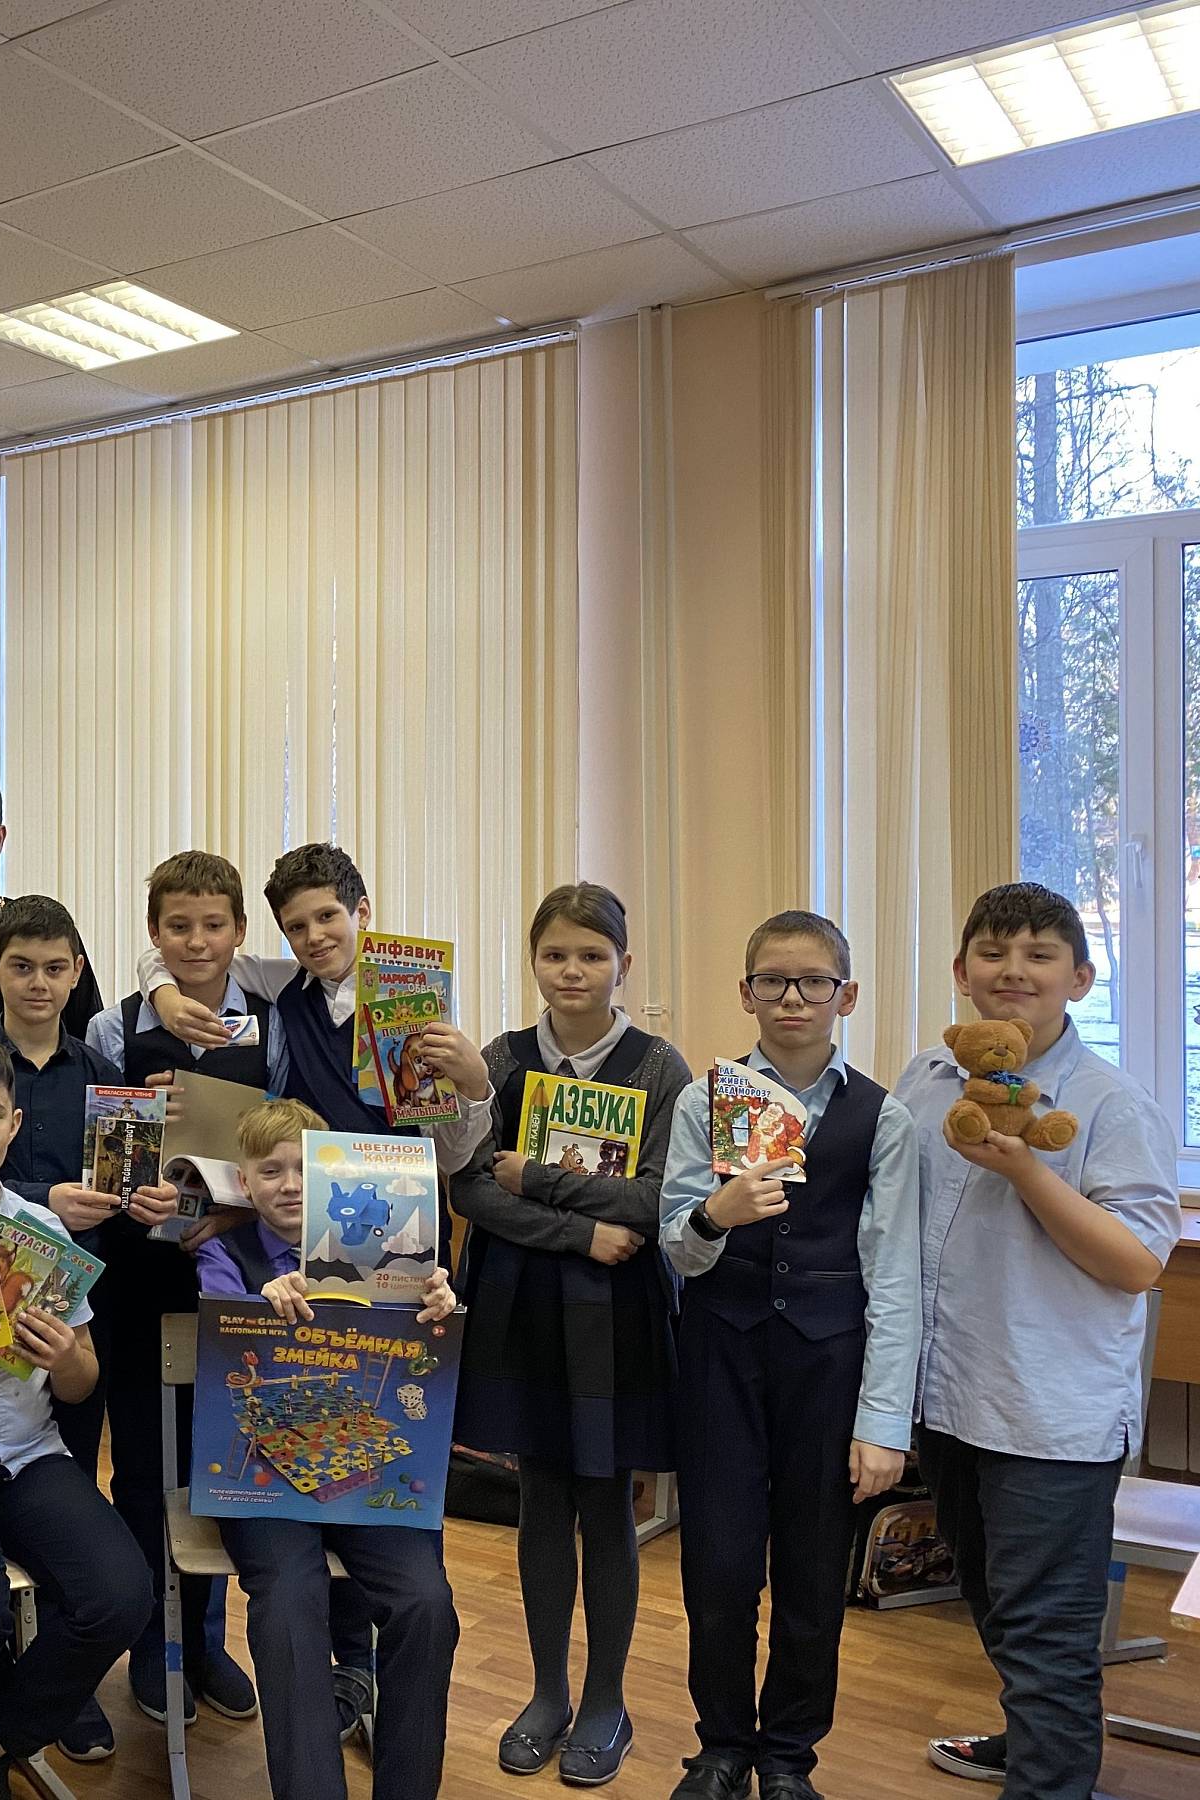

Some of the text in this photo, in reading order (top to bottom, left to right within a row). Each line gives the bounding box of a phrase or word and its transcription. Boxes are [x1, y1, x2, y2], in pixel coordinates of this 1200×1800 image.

[361, 936, 446, 963] Алфавит
[382, 1021, 431, 1037] ПОТЕШ
[719, 1067, 735, 1075] ГДЕ
[98, 1089, 133, 1097] ВНЕКЛАССНОЕ
[717, 1085, 771, 1097] ДЕД МОРОЗ?
[396, 1103, 454, 1119] МАЛЫШАМ
[549, 1083, 636, 1137] АЗБУКА
[352, 1141, 425, 1154] ЦВЕТНОЙ
[363, 1152, 426, 1166] КАРТОН
[375, 1273, 389, 1281] 20
[375, 1281, 388, 1289] 10
[219, 1326, 288, 1336] НАСТОЛЬНАЯ ИГРА
[294, 1325, 422, 1359] ОБЪЁМНАЯ
[272, 1346, 360, 1371] ЗМЕЙКА
